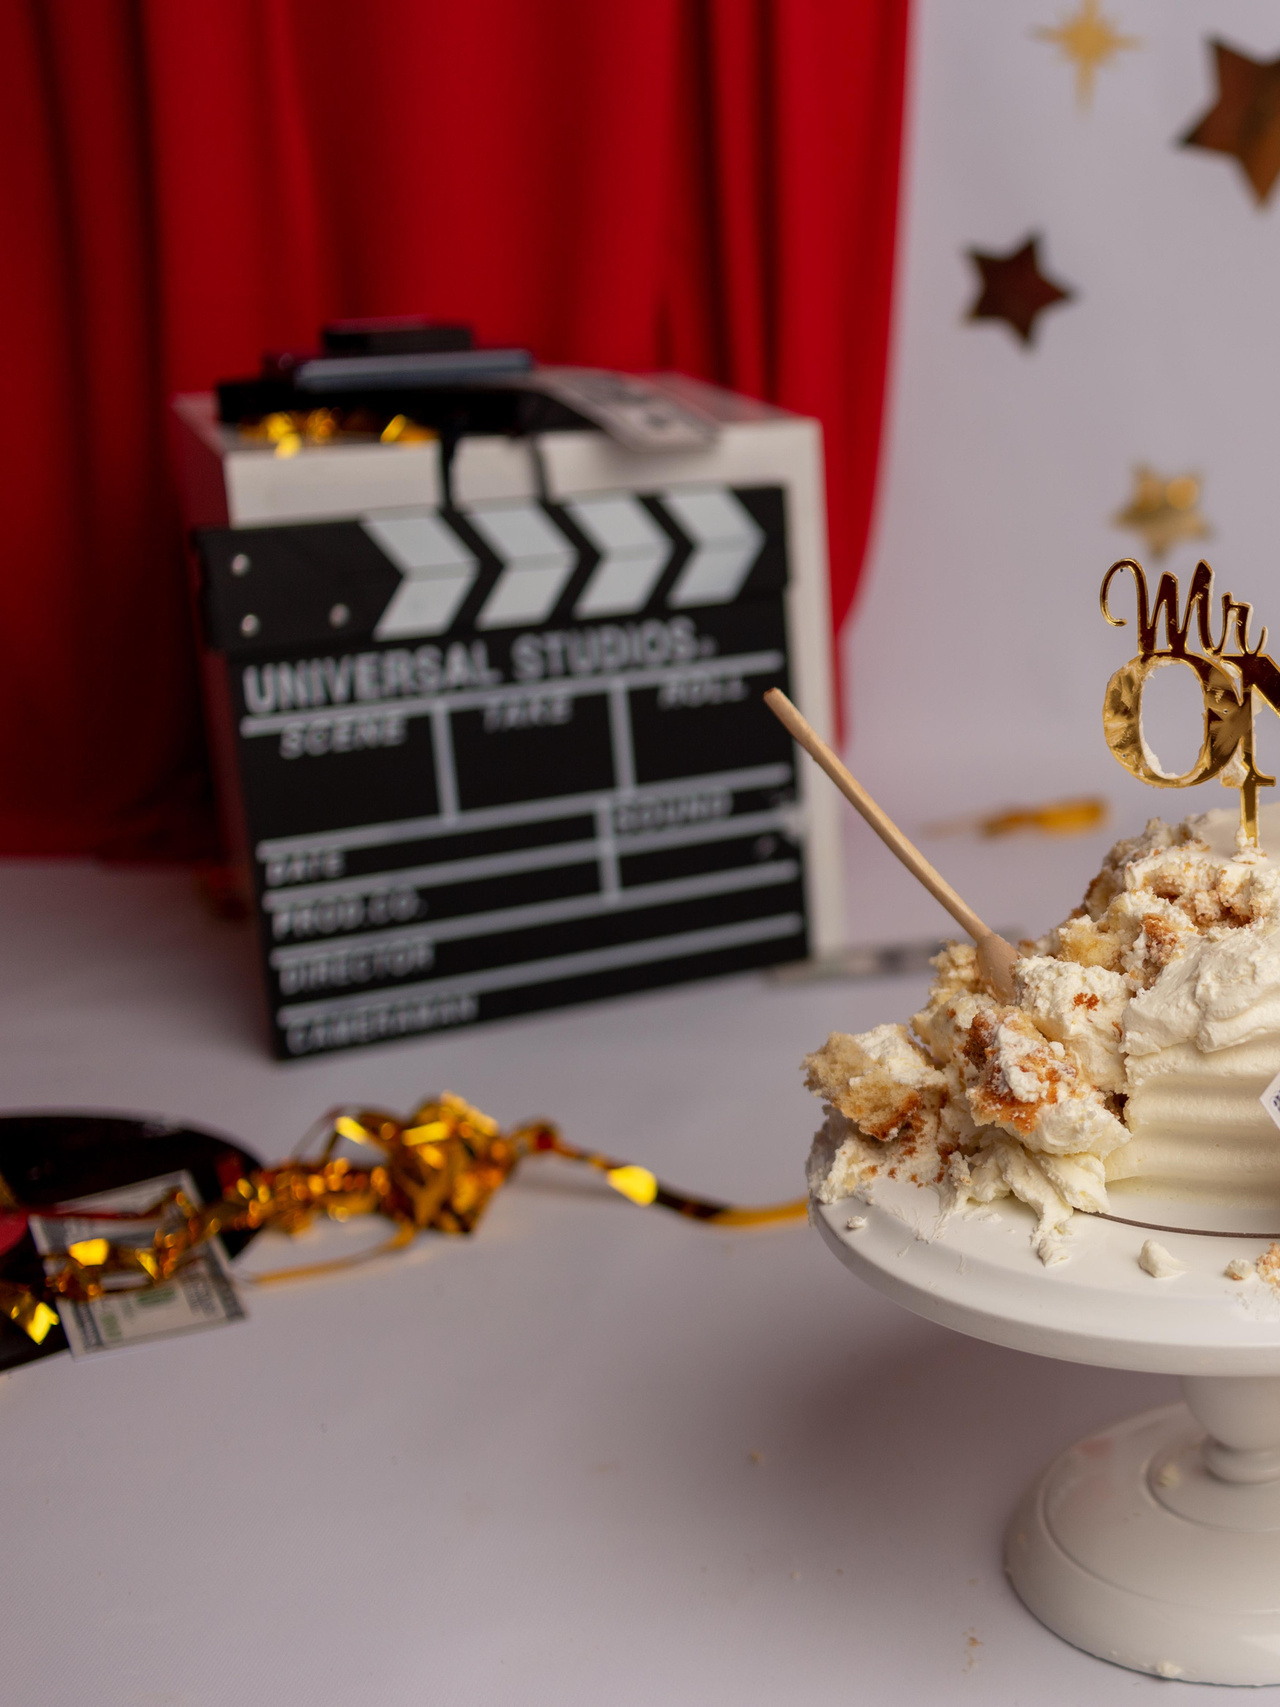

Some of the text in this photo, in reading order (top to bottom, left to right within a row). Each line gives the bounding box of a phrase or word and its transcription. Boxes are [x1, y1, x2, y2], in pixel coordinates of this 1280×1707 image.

[1101, 558, 1268, 656] Mr
[242, 639, 502, 716] UNIVERSAL
[279, 708, 407, 760] SCENE
[279, 939, 436, 996] DIRECTOR
